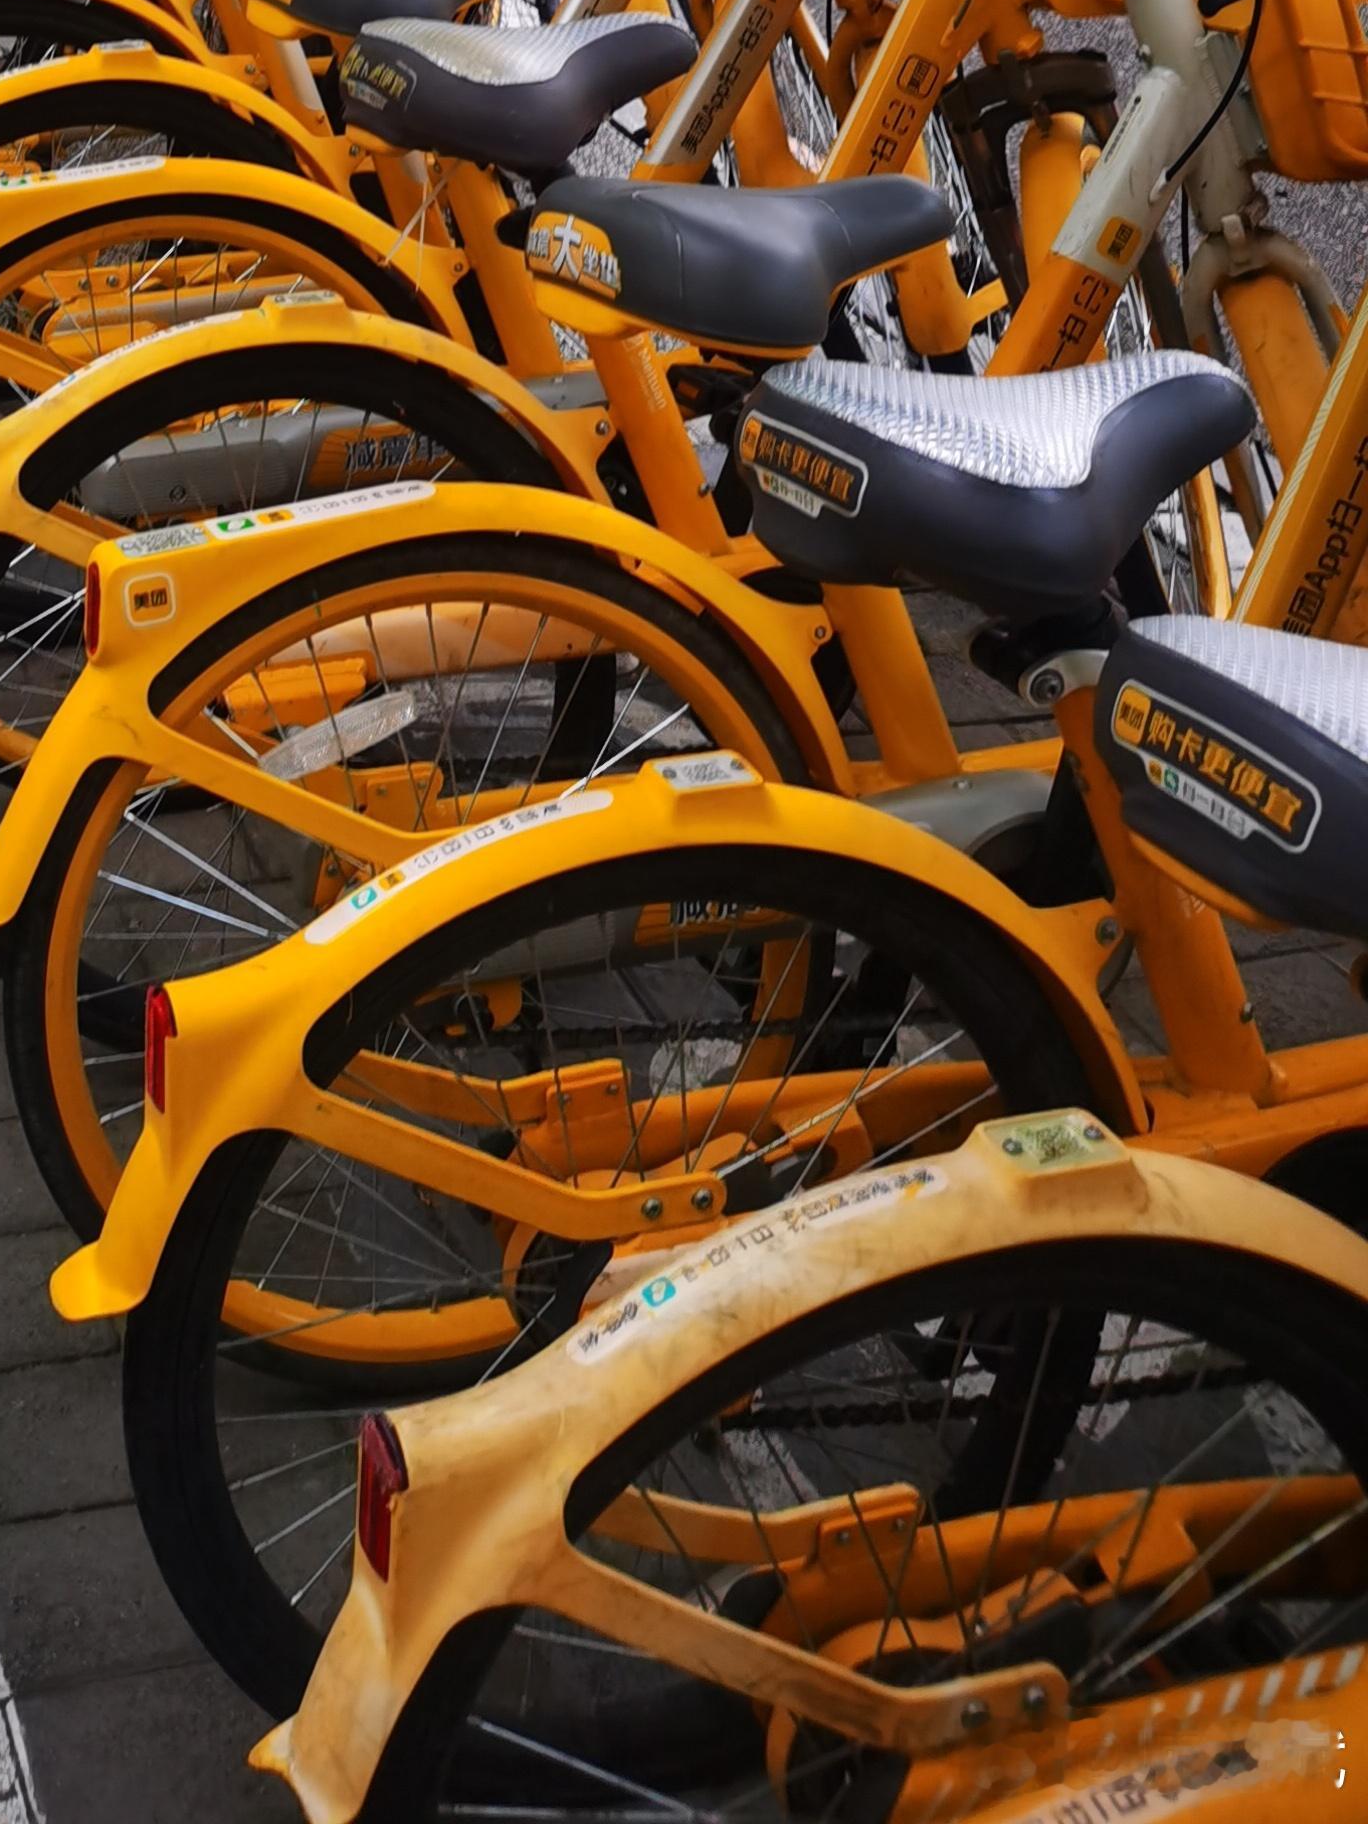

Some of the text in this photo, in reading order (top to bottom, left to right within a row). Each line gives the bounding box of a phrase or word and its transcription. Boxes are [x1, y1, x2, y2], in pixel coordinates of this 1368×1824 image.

[1107, 223, 1134, 258] 美团
[1146, 708, 1303, 833] 购卡更便宜
